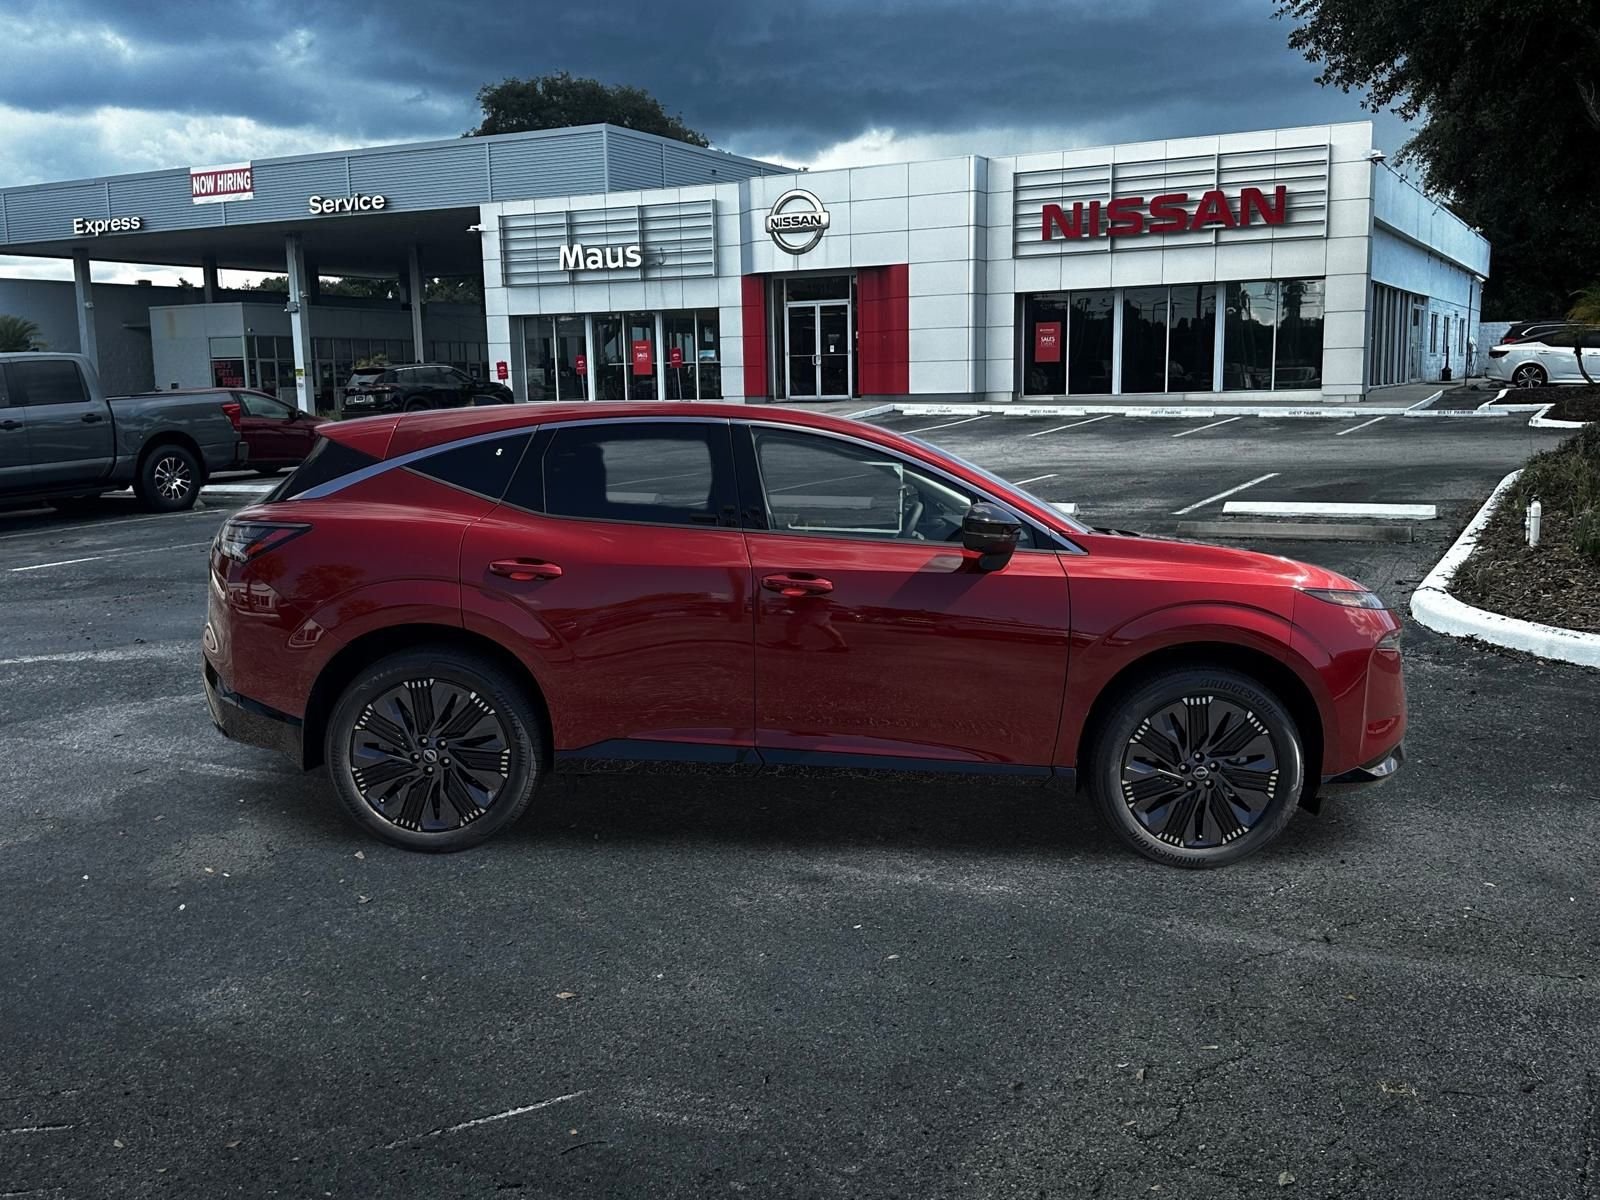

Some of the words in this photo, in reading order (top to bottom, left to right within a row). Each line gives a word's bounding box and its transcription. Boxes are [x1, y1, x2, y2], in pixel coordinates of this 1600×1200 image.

[192, 175, 215, 194] NOW
[217, 171, 250, 192] HIRING
[309, 193, 385, 214] Service
[1042, 185, 1286, 241] NISSAN
[73, 216, 142, 236] Express
[770, 213, 822, 229] NISSAN
[558, 244, 642, 271] Maus
[1199, 678, 1278, 716] BRIDGESTONE
